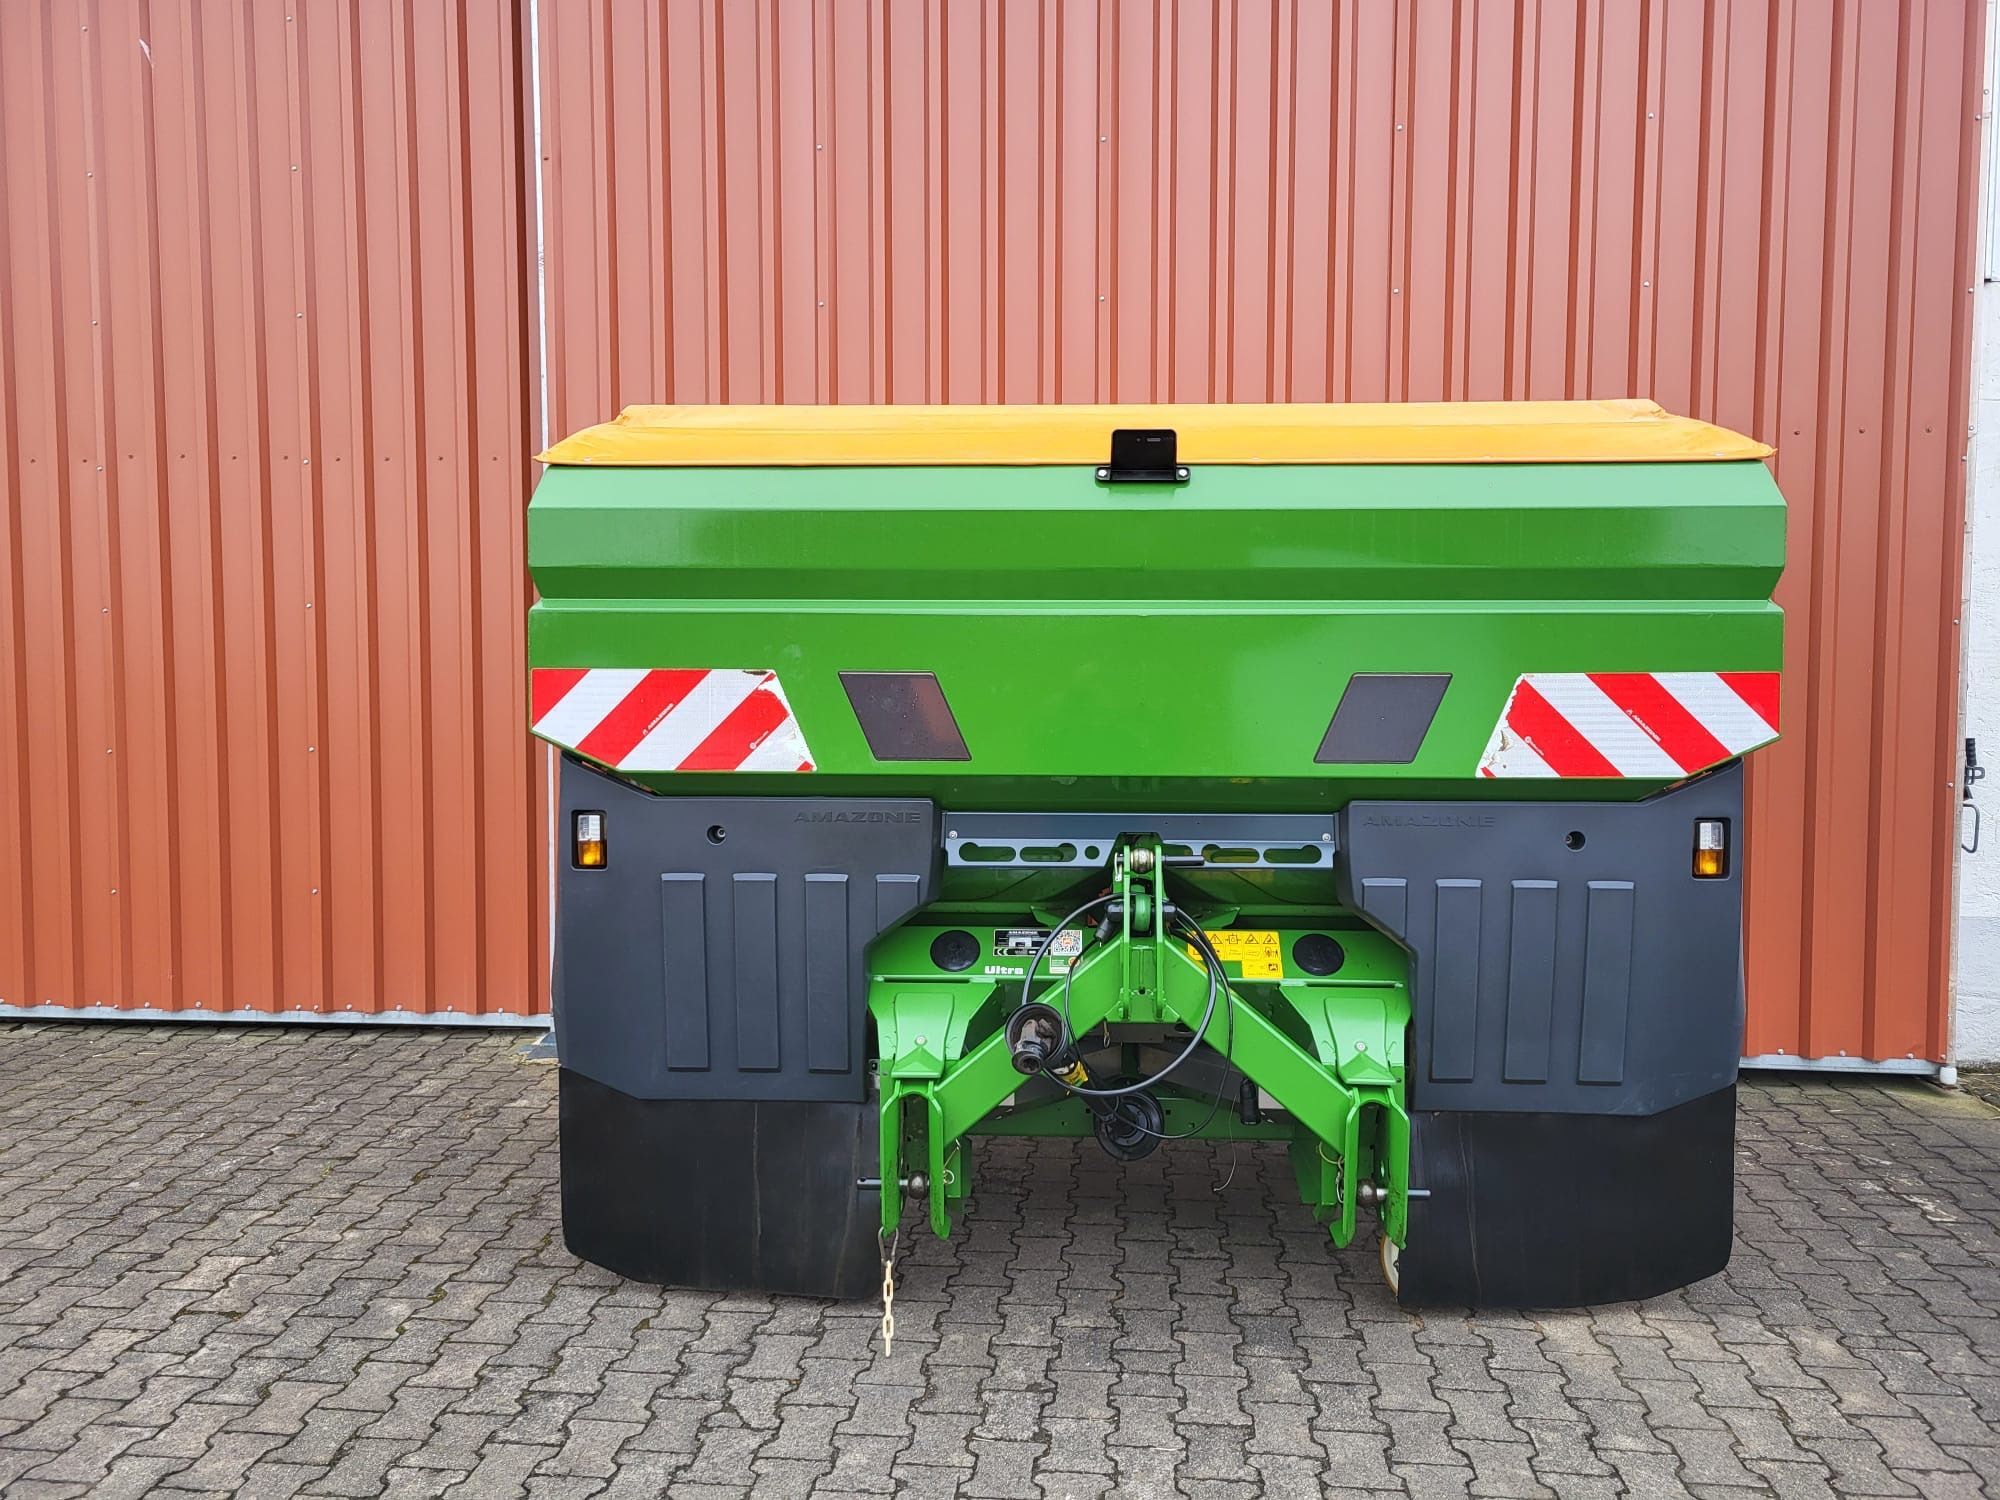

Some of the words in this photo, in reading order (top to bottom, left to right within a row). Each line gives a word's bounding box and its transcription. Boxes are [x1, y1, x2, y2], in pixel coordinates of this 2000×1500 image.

[793, 811, 921, 824] AMAZONE
[1360, 815, 1496, 828] AMAZONE
[984, 965, 1024, 975] Ultra
